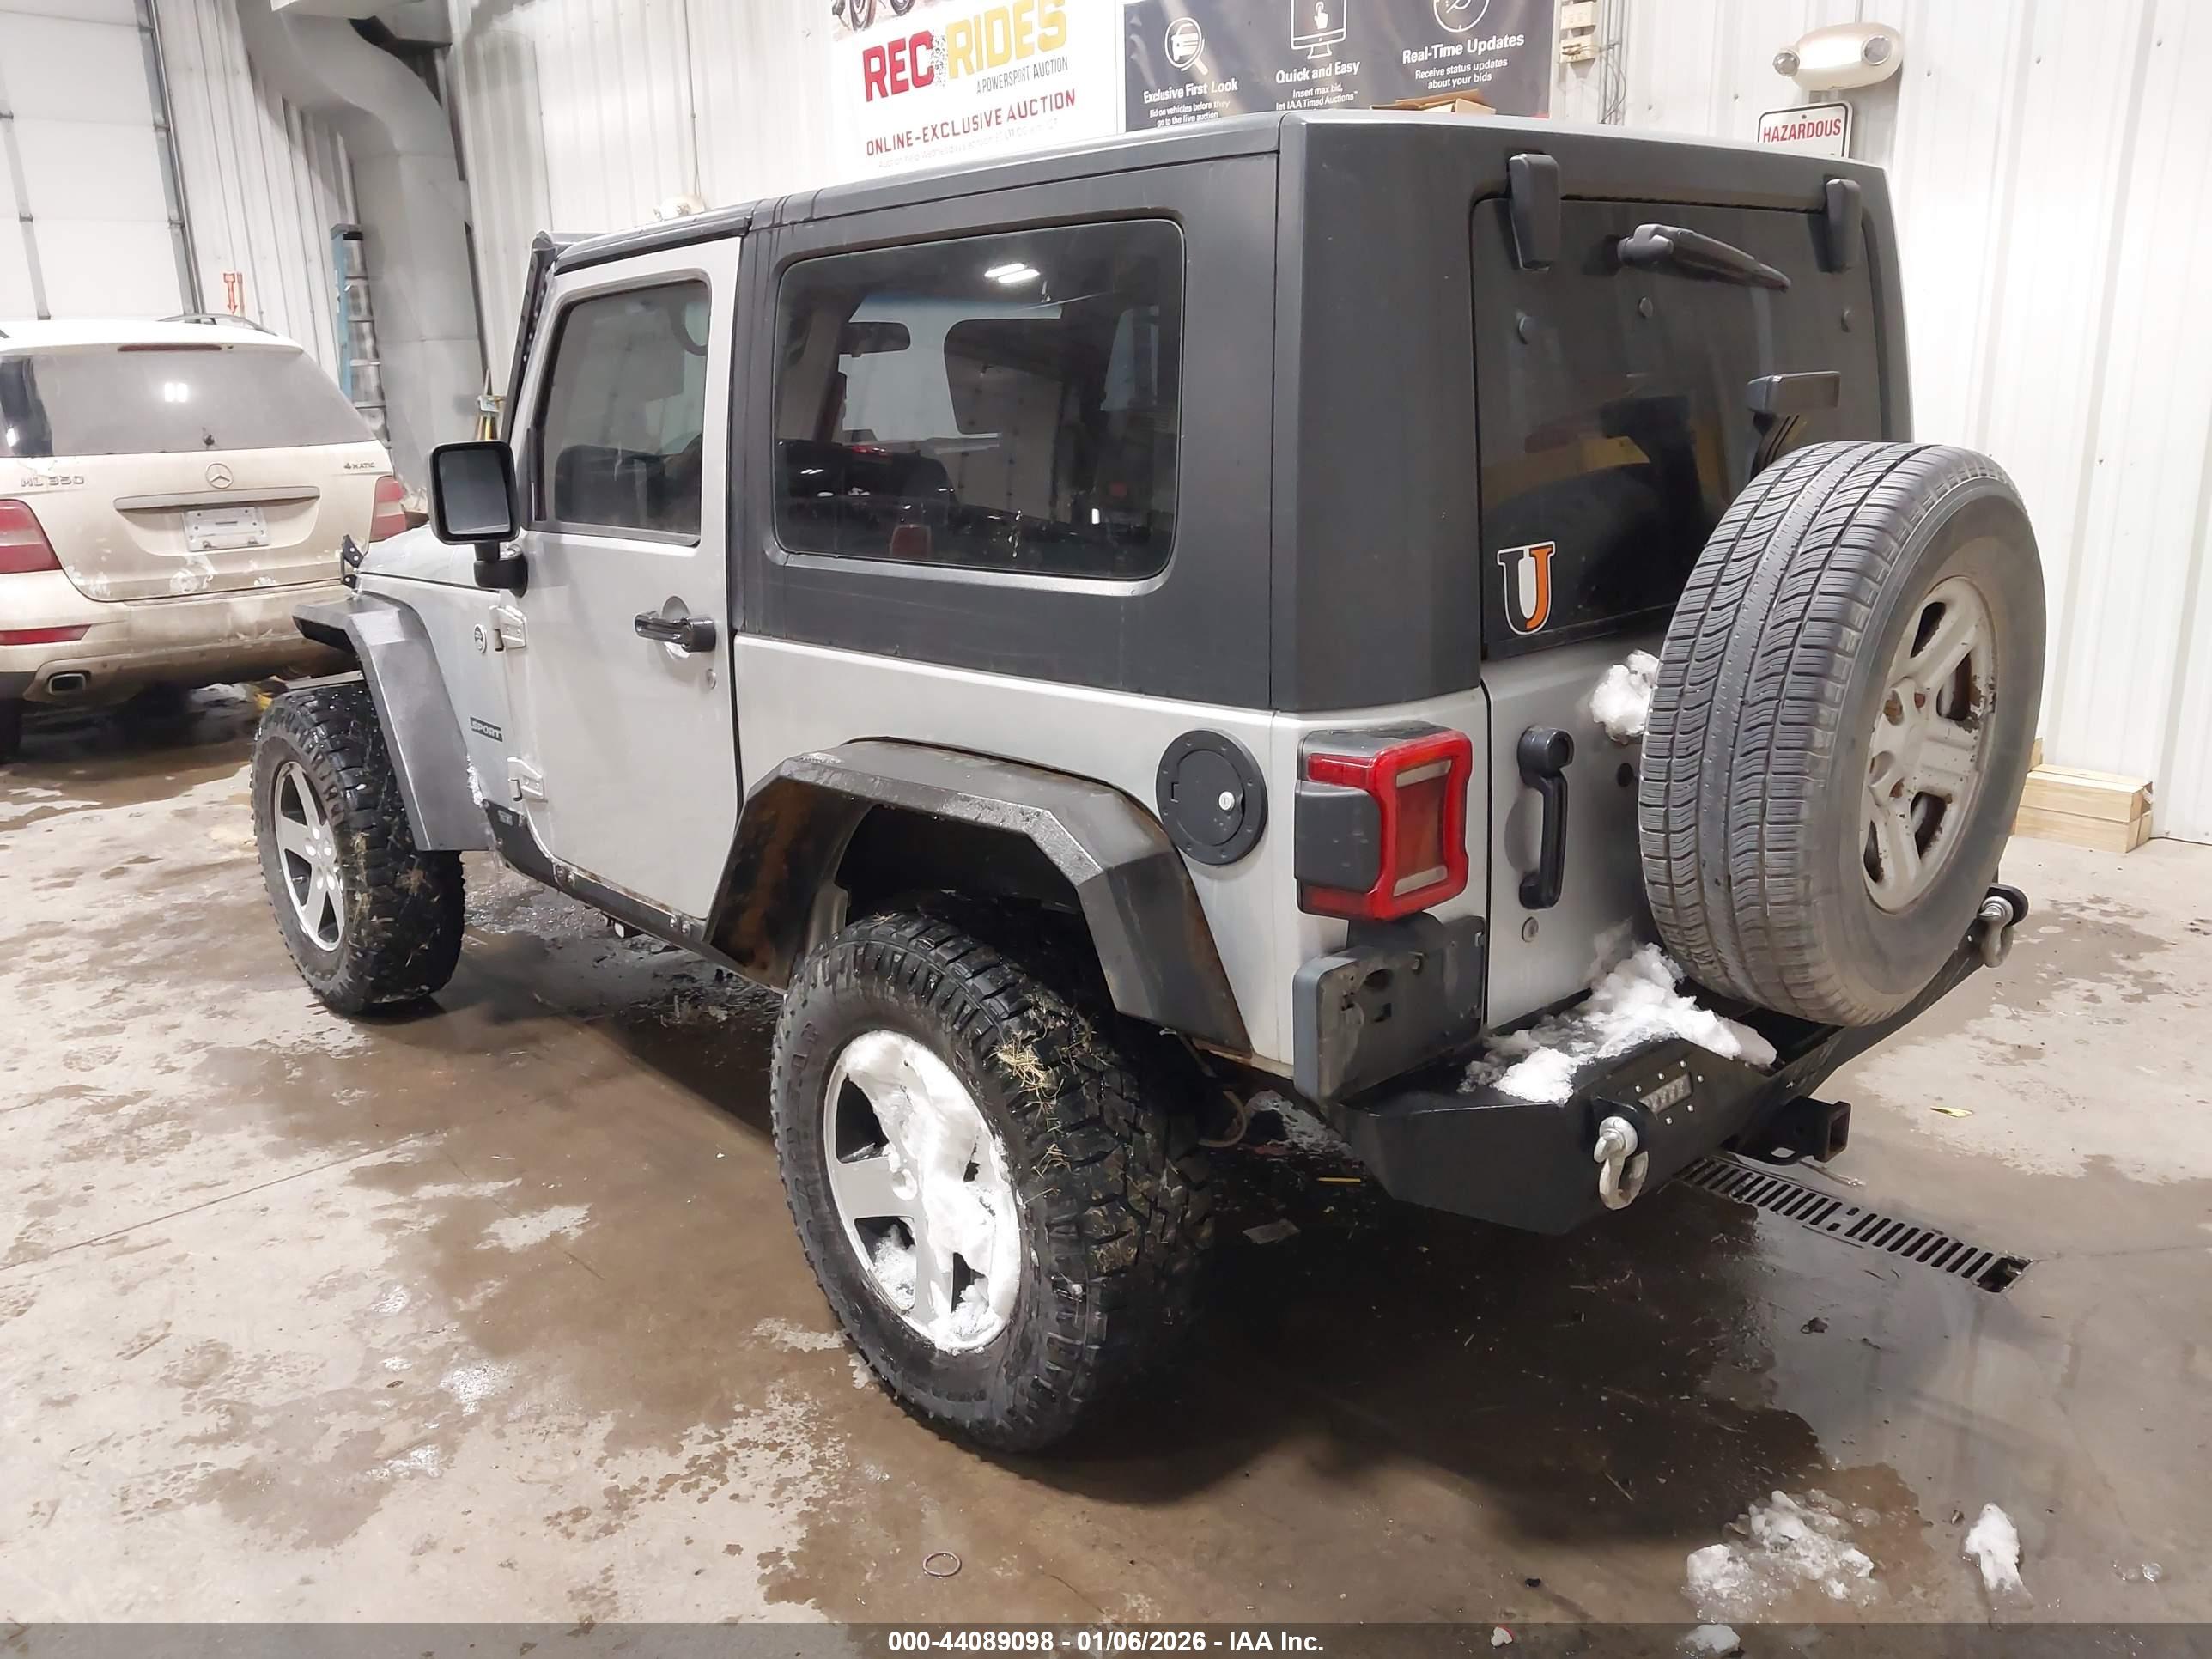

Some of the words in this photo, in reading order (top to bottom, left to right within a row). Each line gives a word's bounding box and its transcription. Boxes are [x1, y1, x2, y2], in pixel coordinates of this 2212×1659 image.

[862, 29, 934, 102] REC
[946, 0, 1066, 79] RIDES
[1402, 43, 1463, 64] Real-Time
[1467, 33, 1525, 55] Updates
[982, 65, 1030, 94] POWERSPORT
[1033, 55, 1068, 79] AUCTION
[1275, 67, 1310, 83] Quick
[1311, 63, 1333, 79] and
[1334, 61, 1360, 76] Easy
[1415, 67, 1445, 80] Receive
[1446, 63, 1471, 75] status
[1473, 58, 1508, 72] updates
[1427, 78, 1451, 89] about
[1452, 75, 1471, 88] your
[1473, 71, 1492, 83] bids
[1143, 87, 1184, 104] Exclusive
[1185, 82, 1208, 97] First
[1211, 77, 1238, 93] Look
[1292, 88, 1313, 99] Insert
[1314, 86, 1330, 94] max
[1166, 105, 1192, 114] vehicles
[1193, 101, 1212, 111] before
[1287, 100, 1303, 110] IAA
[1303, 95, 1323, 107] Timed
[866, 108, 1002, 155] ONLINE-EXCLUSIVE
[1006, 88, 1074, 122] AUCTION
[1171, 115, 1182, 125] the
[1182, 114, 1196, 123] live
[1763, 118, 1842, 143] HAZARDOUS
[20, 477, 44, 487] ML
[48, 475, 85, 486] 350
[471, 720, 503, 740] SPORT
